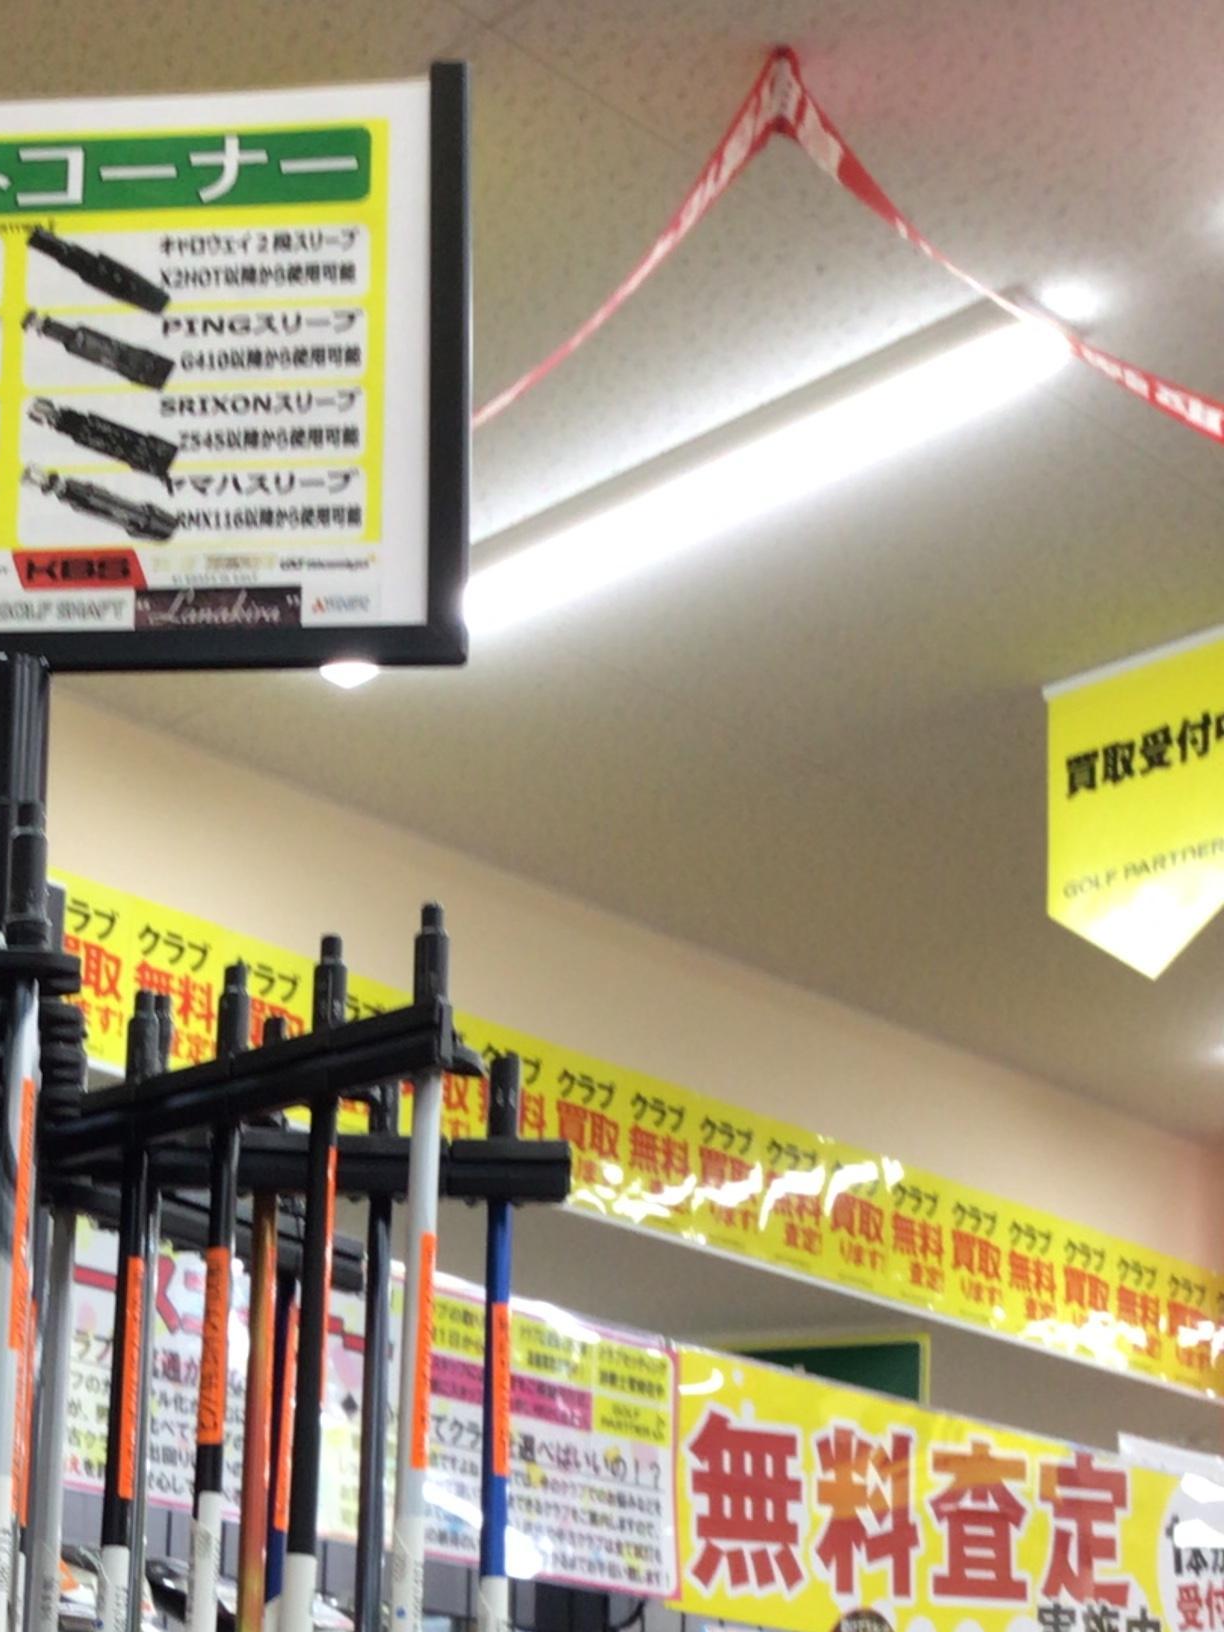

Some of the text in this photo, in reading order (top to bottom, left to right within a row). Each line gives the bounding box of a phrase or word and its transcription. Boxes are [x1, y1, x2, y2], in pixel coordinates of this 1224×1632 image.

[1065, 712, 1224, 799] 買取受付
[64, 898, 120, 941] ラブ
[137, 924, 211, 972] クラブ
[246, 963, 301, 1002] ラブ
[558, 1068, 615, 1110] クラブ
[631, 1092, 684, 1132] クラブ
[629, 1124, 690, 1178] 無料
[700, 1115, 753, 1155] クラブ
[767, 1137, 819, 1173] クラブ
[831, 1192, 884, 1245] 買取
[893, 1183, 939, 1219] クラブ
[952, 1201, 997, 1237] クラブ
[892, 1211, 943, 1264] 無料
[951, 1228, 1001, 1281] 買取
[1009, 1221, 1052, 1256] クラブ
[1064, 1238, 1106, 1273] クラブ
[1009, 1249, 1056, 1301] 無料
[1118, 1256, 1157, 1290] クラブ
[1167, 1274, 1206, 1306] クラブ
[687, 1411, 1132, 1607] 無料査定
